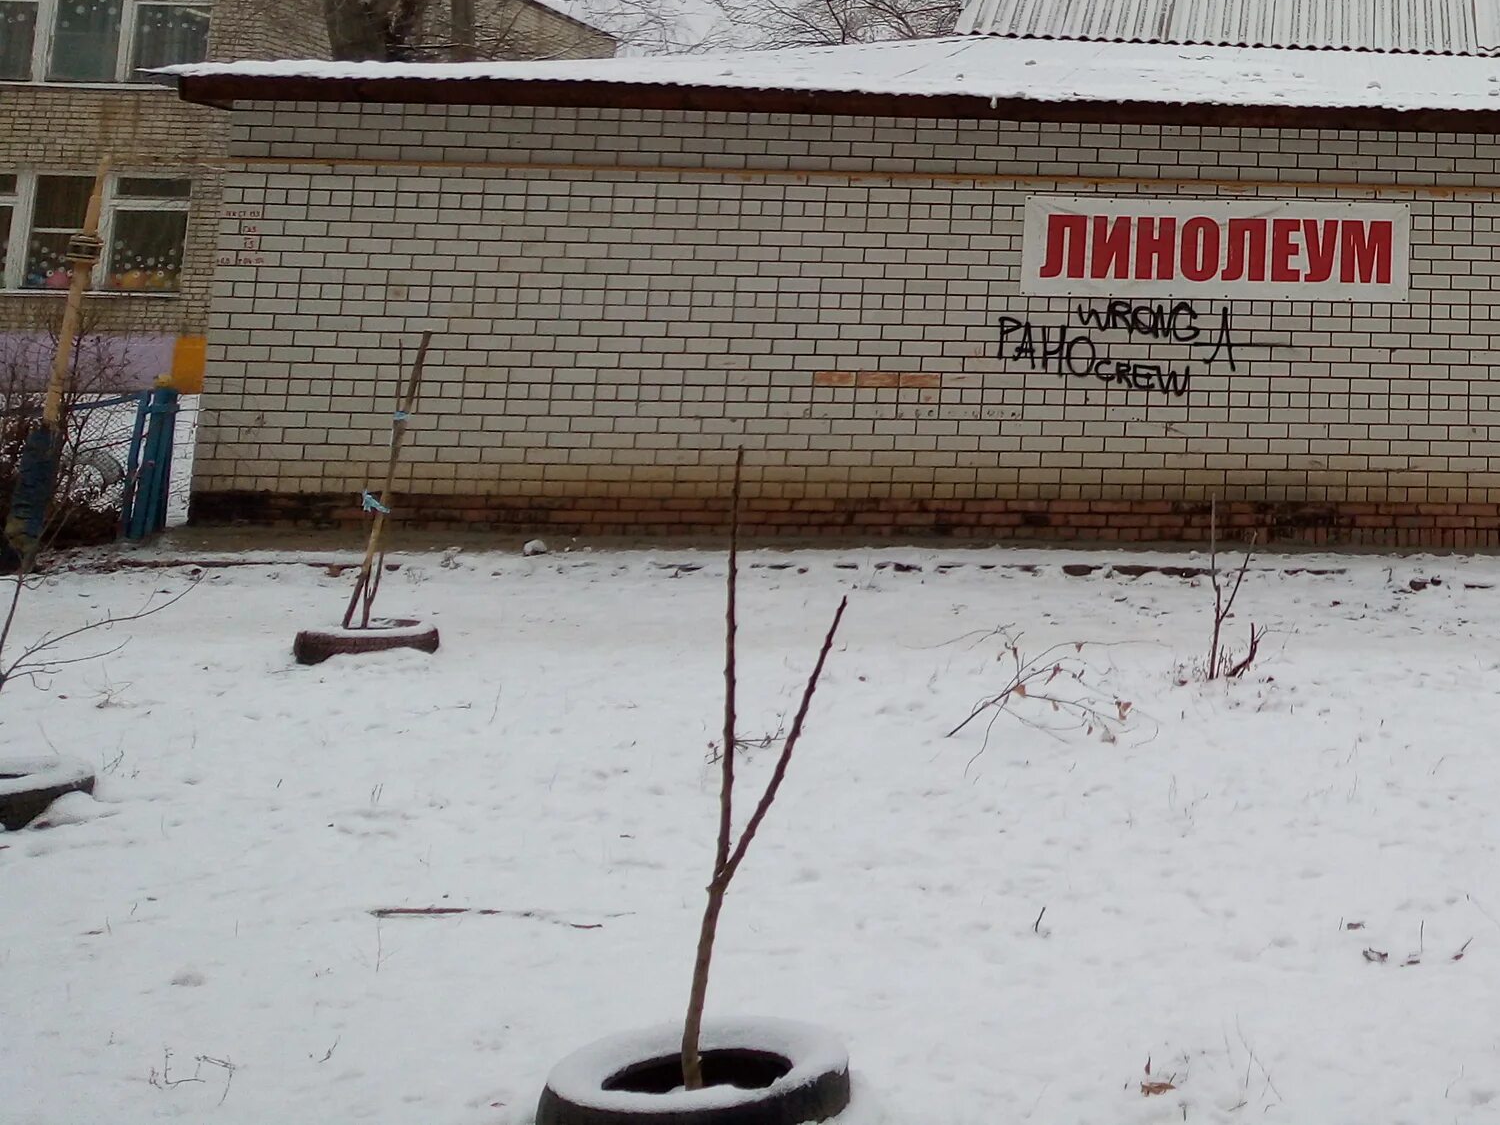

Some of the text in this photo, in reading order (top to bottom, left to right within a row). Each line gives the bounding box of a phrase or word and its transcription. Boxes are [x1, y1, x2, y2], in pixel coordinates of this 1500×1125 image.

[1039, 213, 1393, 284] ЛИНОЛЕУМ
[1078, 300, 1200, 342] WRONG
[1094, 359, 1190, 397] CREW
